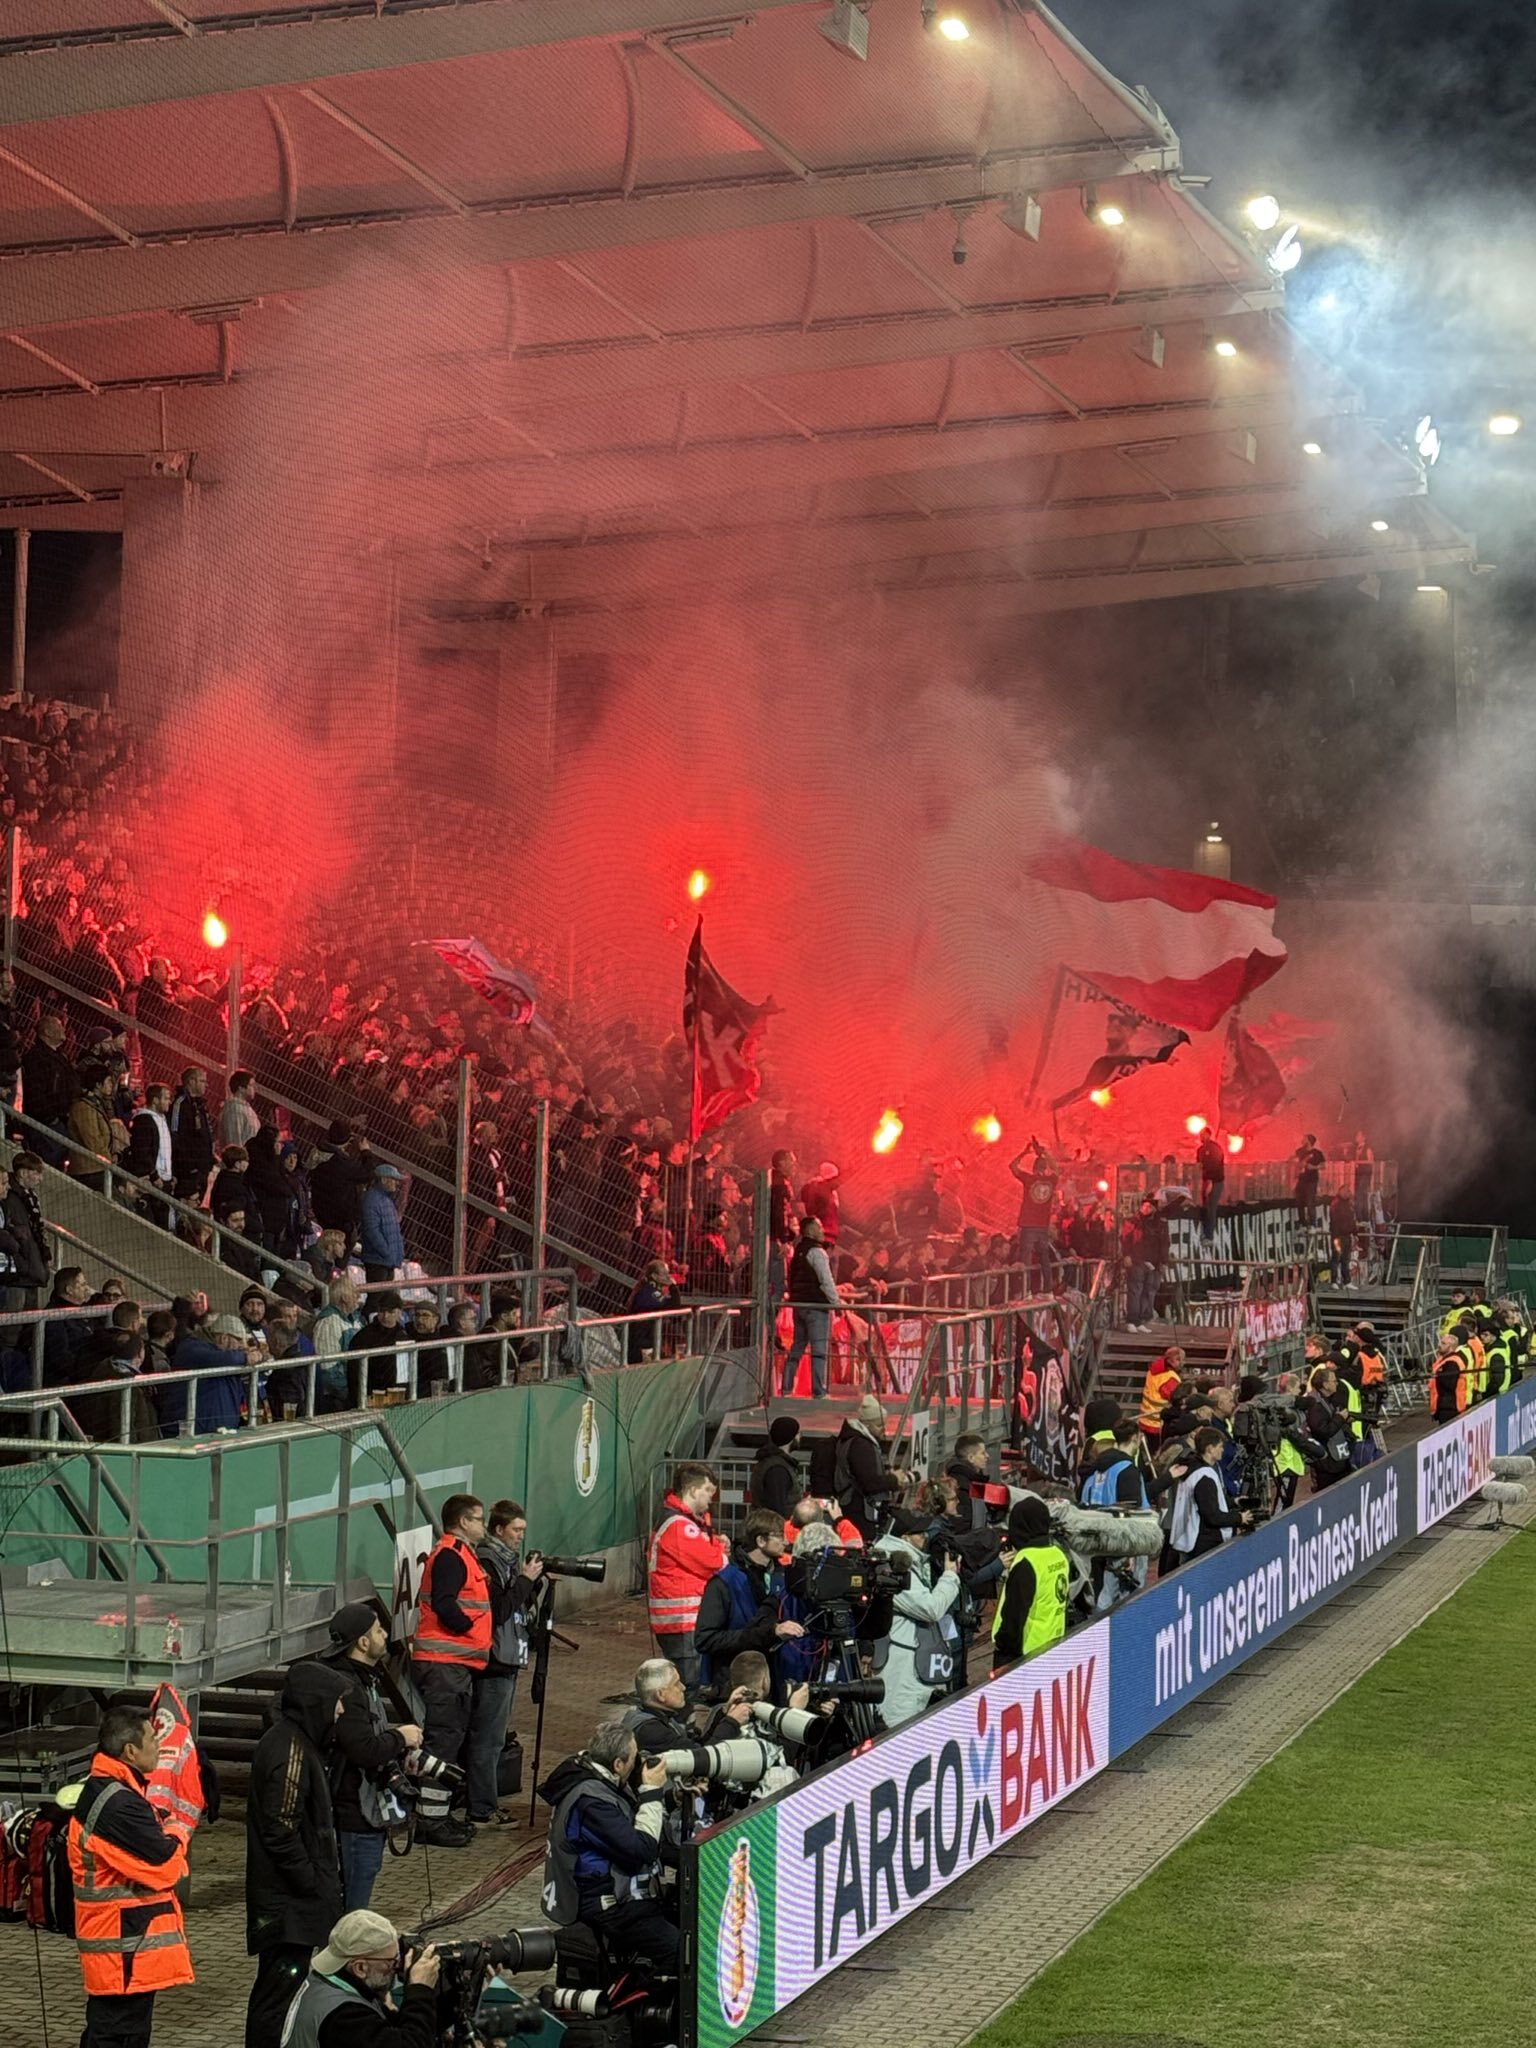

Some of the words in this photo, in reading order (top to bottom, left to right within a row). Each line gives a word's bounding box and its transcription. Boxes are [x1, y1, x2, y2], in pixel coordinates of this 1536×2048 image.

[1155, 1586, 1193, 1707] mit
[1199, 1556, 1283, 1674] unserem
[1288, 1466, 1399, 1612] Business-Kredit
